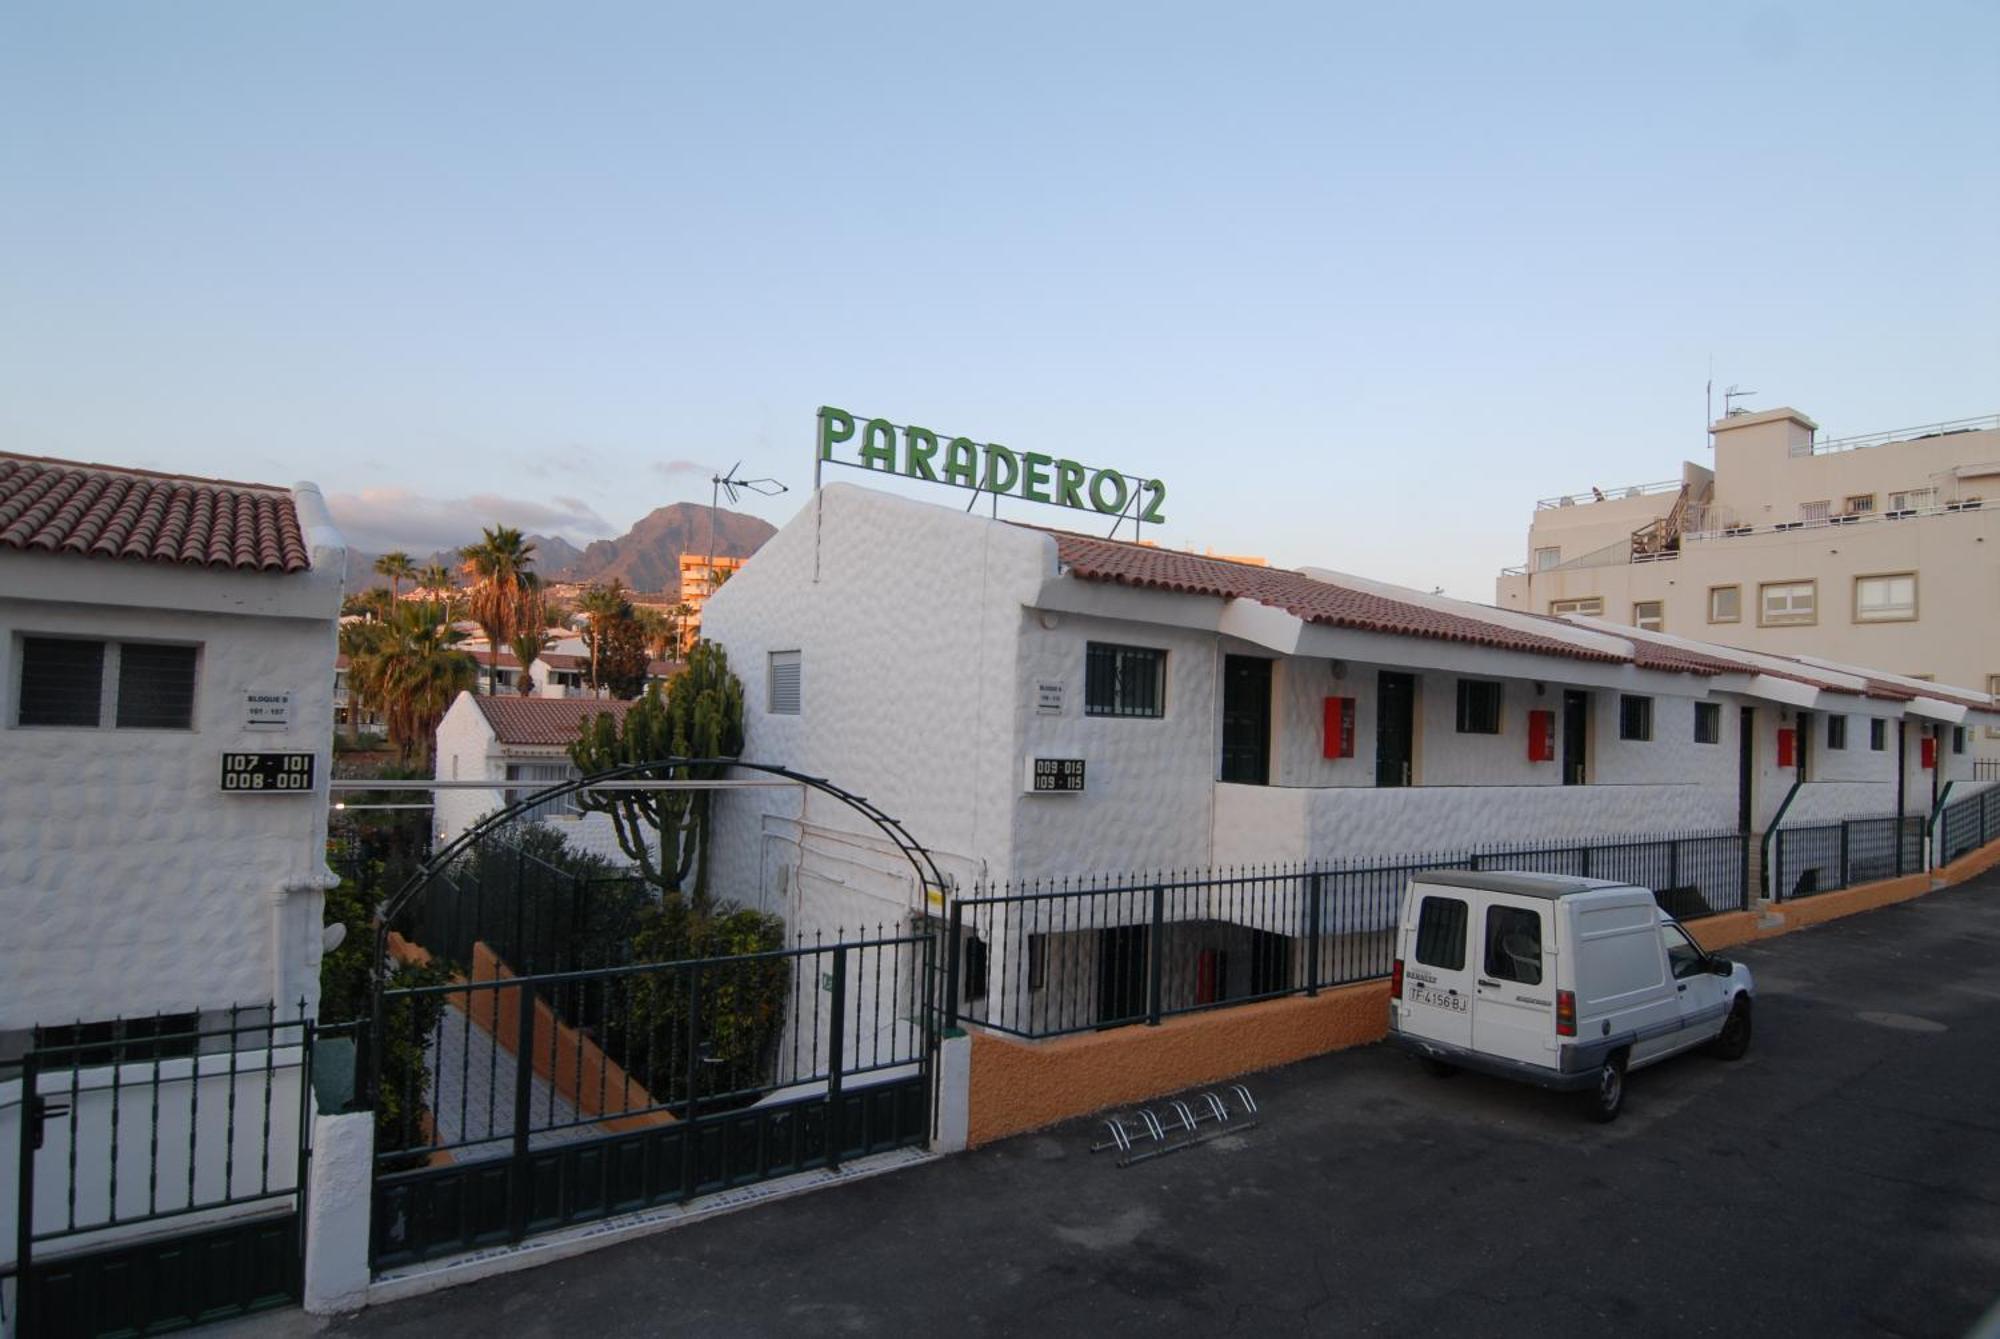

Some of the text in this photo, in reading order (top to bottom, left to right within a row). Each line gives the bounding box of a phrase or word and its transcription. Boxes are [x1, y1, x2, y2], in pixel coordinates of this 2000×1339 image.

[819, 405, 1166, 524] PARADERO 2
[248, 695, 280, 703] BLOQUE
[227, 756, 259, 771] 107
[284, 756, 308, 771] 101
[1036, 775, 1055, 789] 109
[1067, 776, 1081, 789] 115
